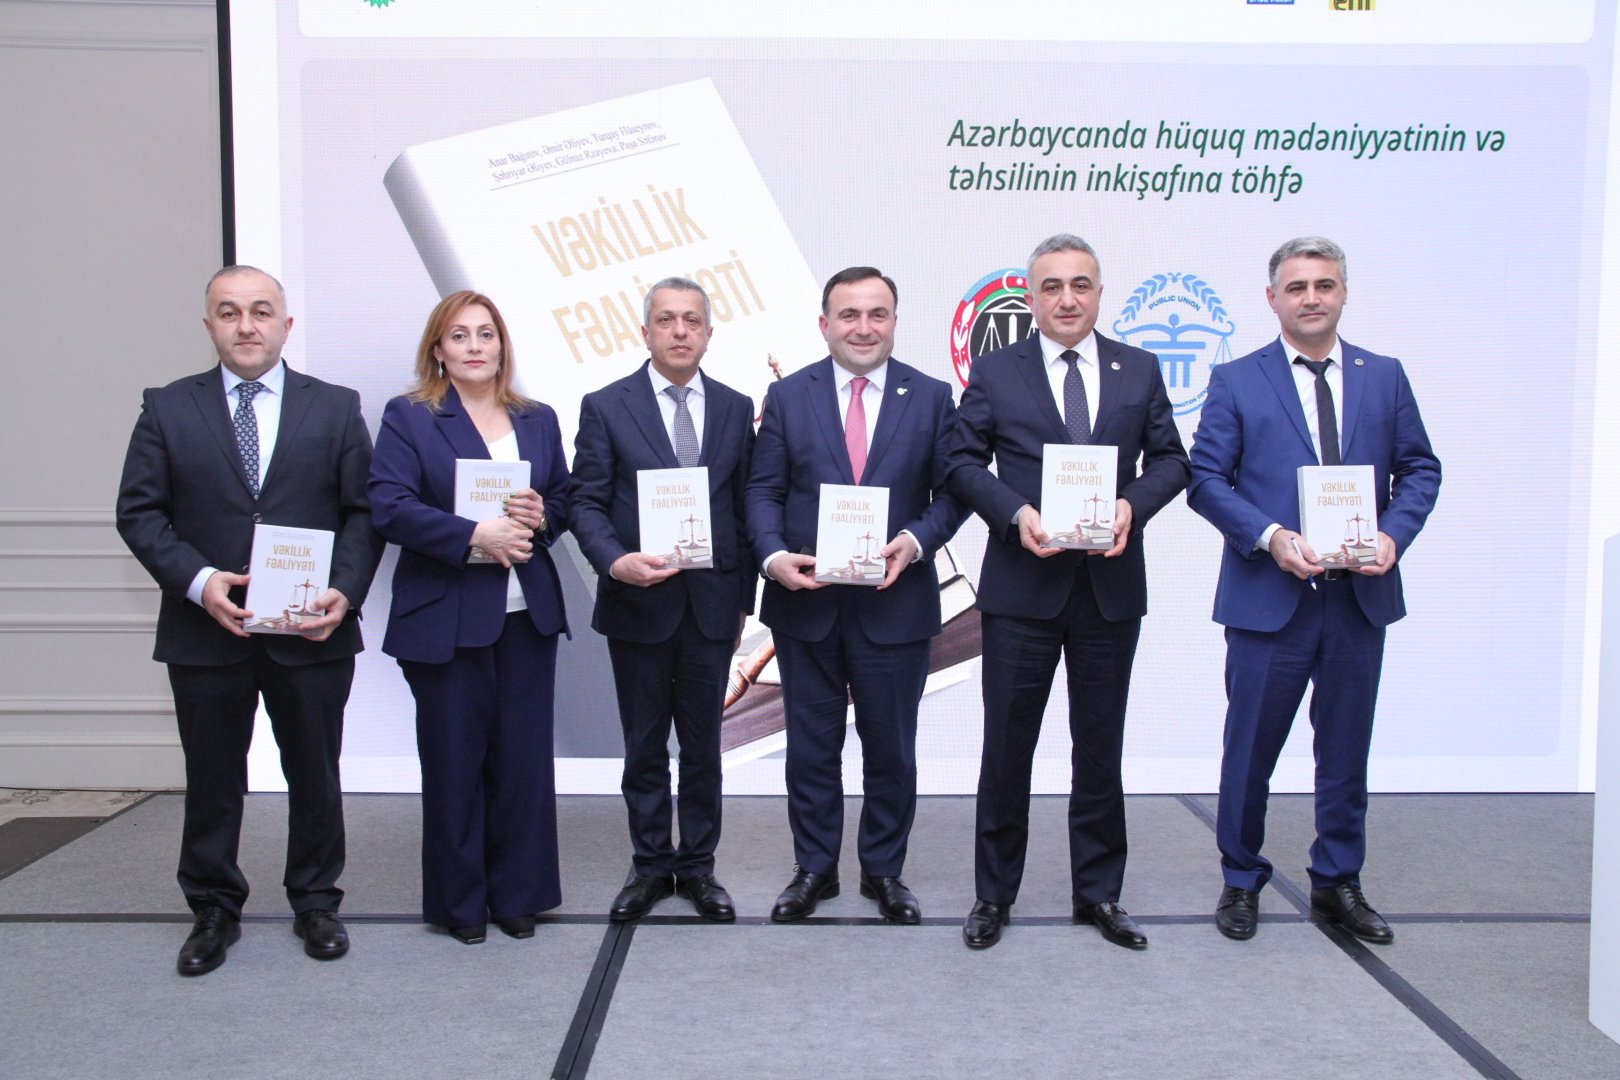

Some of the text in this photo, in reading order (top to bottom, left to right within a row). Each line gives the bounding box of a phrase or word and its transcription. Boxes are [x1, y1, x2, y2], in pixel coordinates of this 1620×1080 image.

[947, 118, 1506, 160] Azərbaycanda hüquq mədəniyyətinin və
[949, 162, 1303, 202] təhsilinin inkişafına töhfə
[531, 184, 708, 278] VƏKİLLİK
[1148, 295, 1201, 311] PUBLIC UNION
[1061, 459, 1098, 473] VƏKİLLİK
[474, 476, 512, 488] VƏKİLLİK
[1055, 473, 1102, 486] FƏALİYYƏTİ
[1321, 480, 1356, 492] VƏKİLLİK
[656, 483, 690, 495] VƏKİLLİK
[651, 496, 696, 509] FƏALİYYƏTİ
[837, 499, 870, 511] VƏKİLLİK
[1317, 493, 1362, 506] FƏALİYYƏTİ
[831, 512, 874, 524] FƏALİYYƏTİ
[273, 544, 312, 557] VƏKİLLİK
[265, 558, 316, 572] FƏALİYYƏTİ
